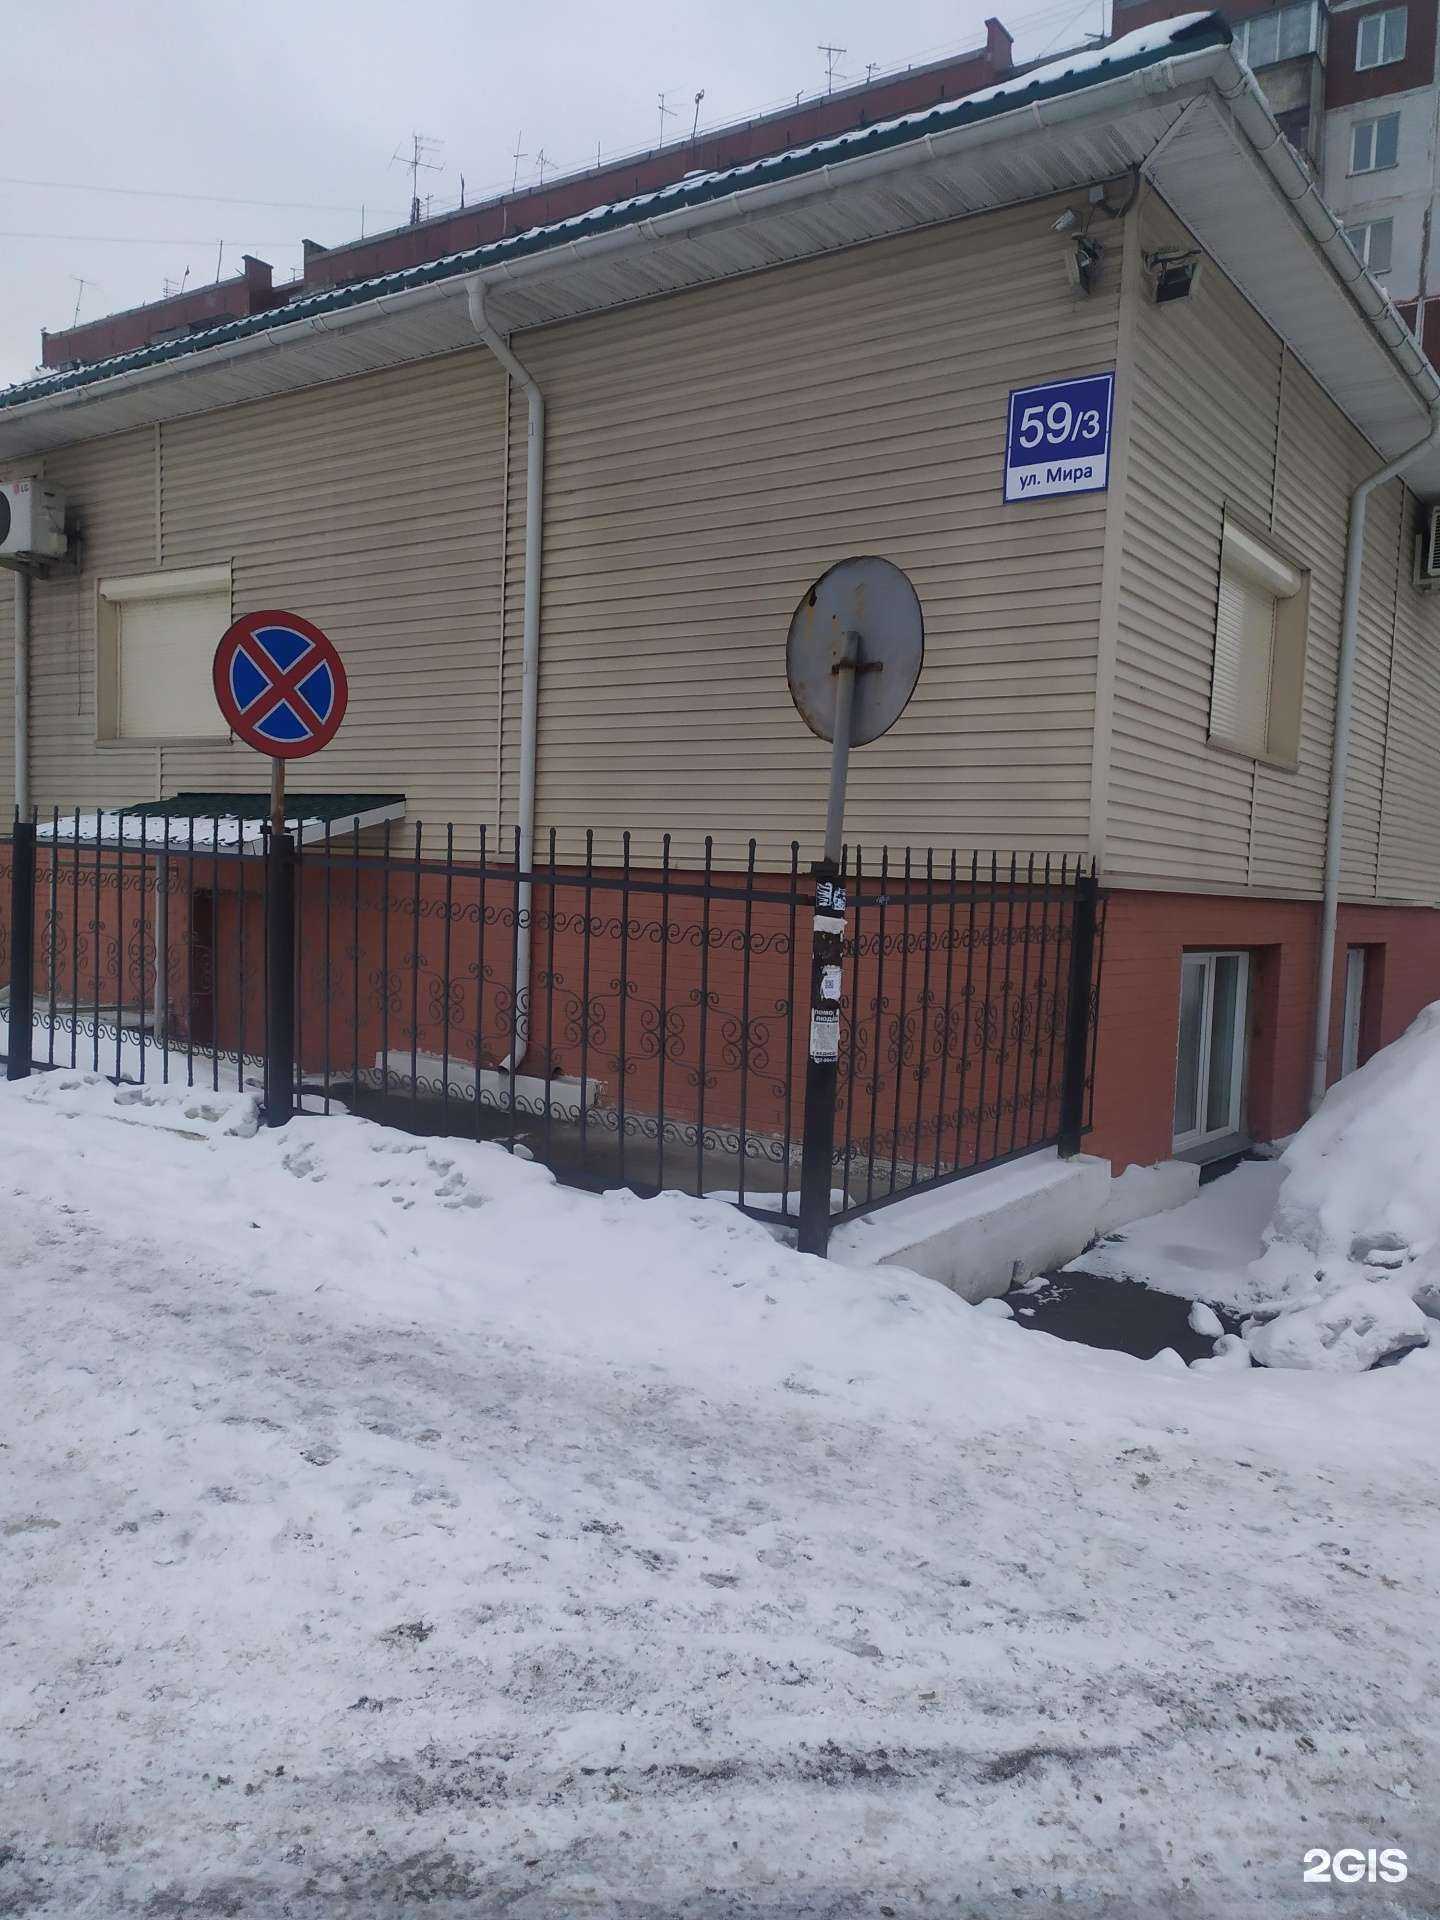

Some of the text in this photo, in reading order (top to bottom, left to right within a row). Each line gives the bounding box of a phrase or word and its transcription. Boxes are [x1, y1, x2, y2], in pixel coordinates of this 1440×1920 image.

[1019, 401, 1100, 448] 59/3
[1019, 466, 1093, 490] ул. Мира
